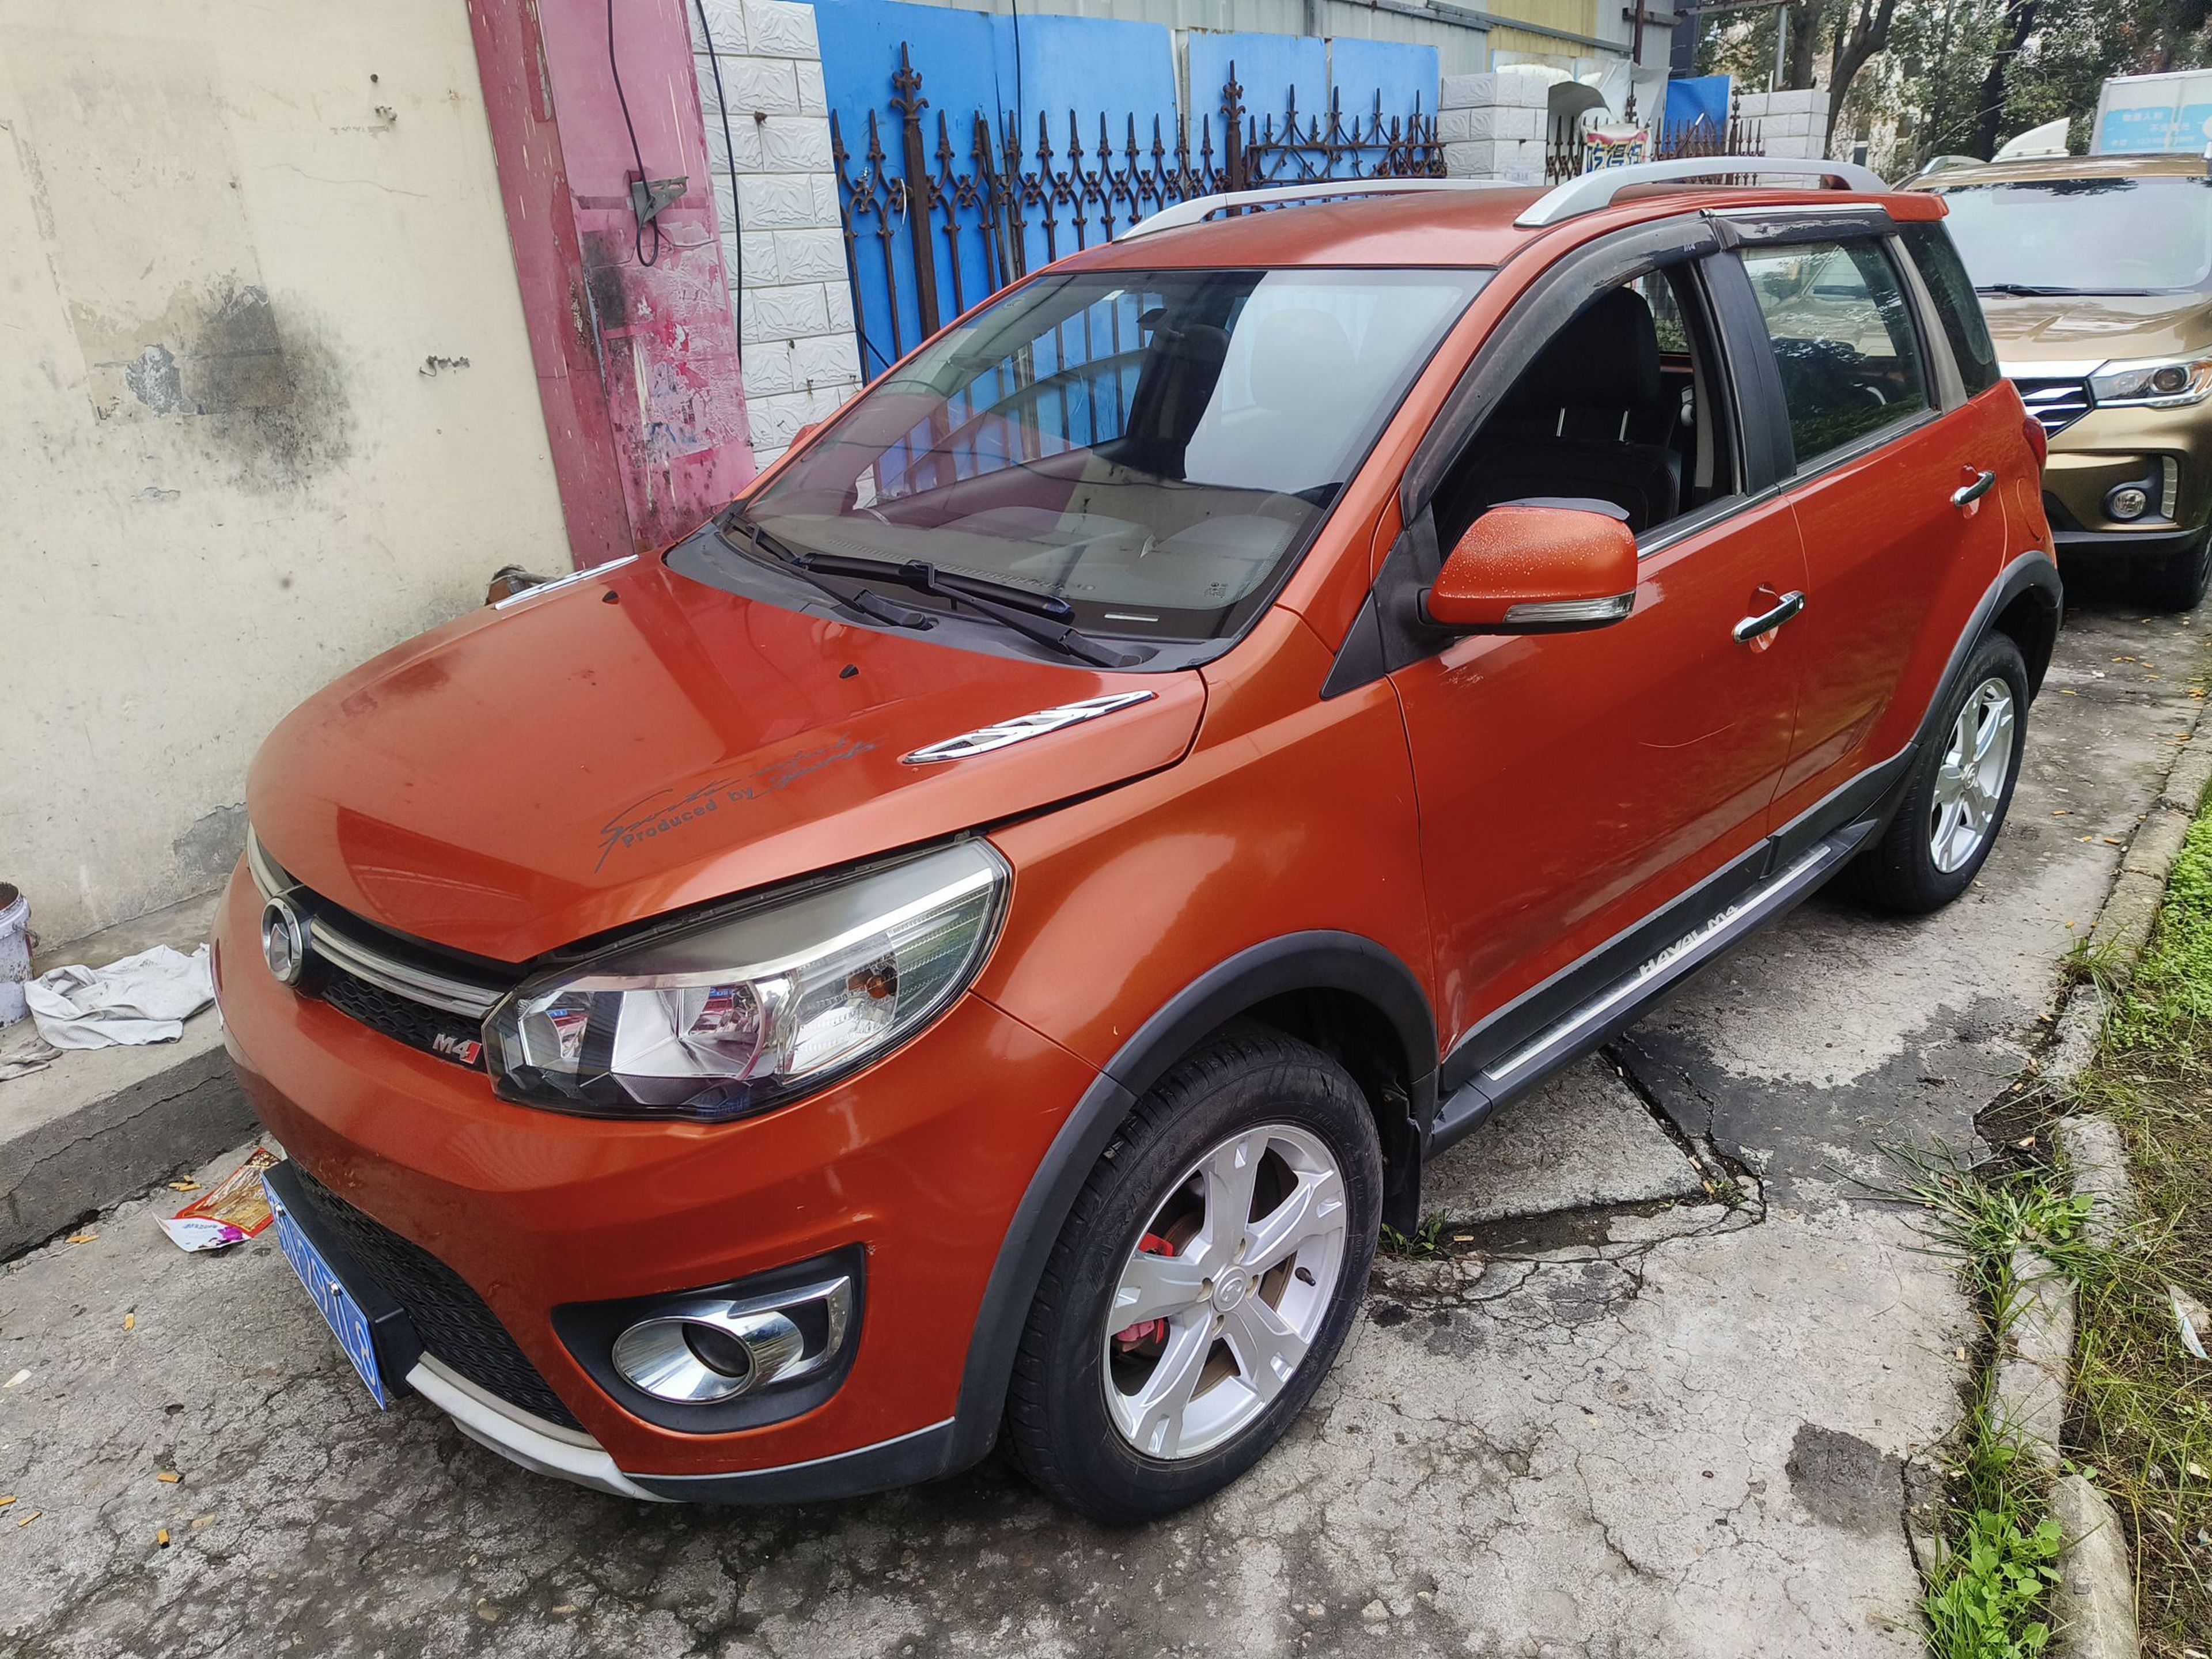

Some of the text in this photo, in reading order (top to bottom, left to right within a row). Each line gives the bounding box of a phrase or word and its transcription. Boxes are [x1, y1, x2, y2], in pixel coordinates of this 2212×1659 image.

[623, 799, 718, 847] Produced
[728, 786, 753, 801] by
[1639, 929, 1706, 976] HAVAL
[433, 1033, 482, 1064] M4
